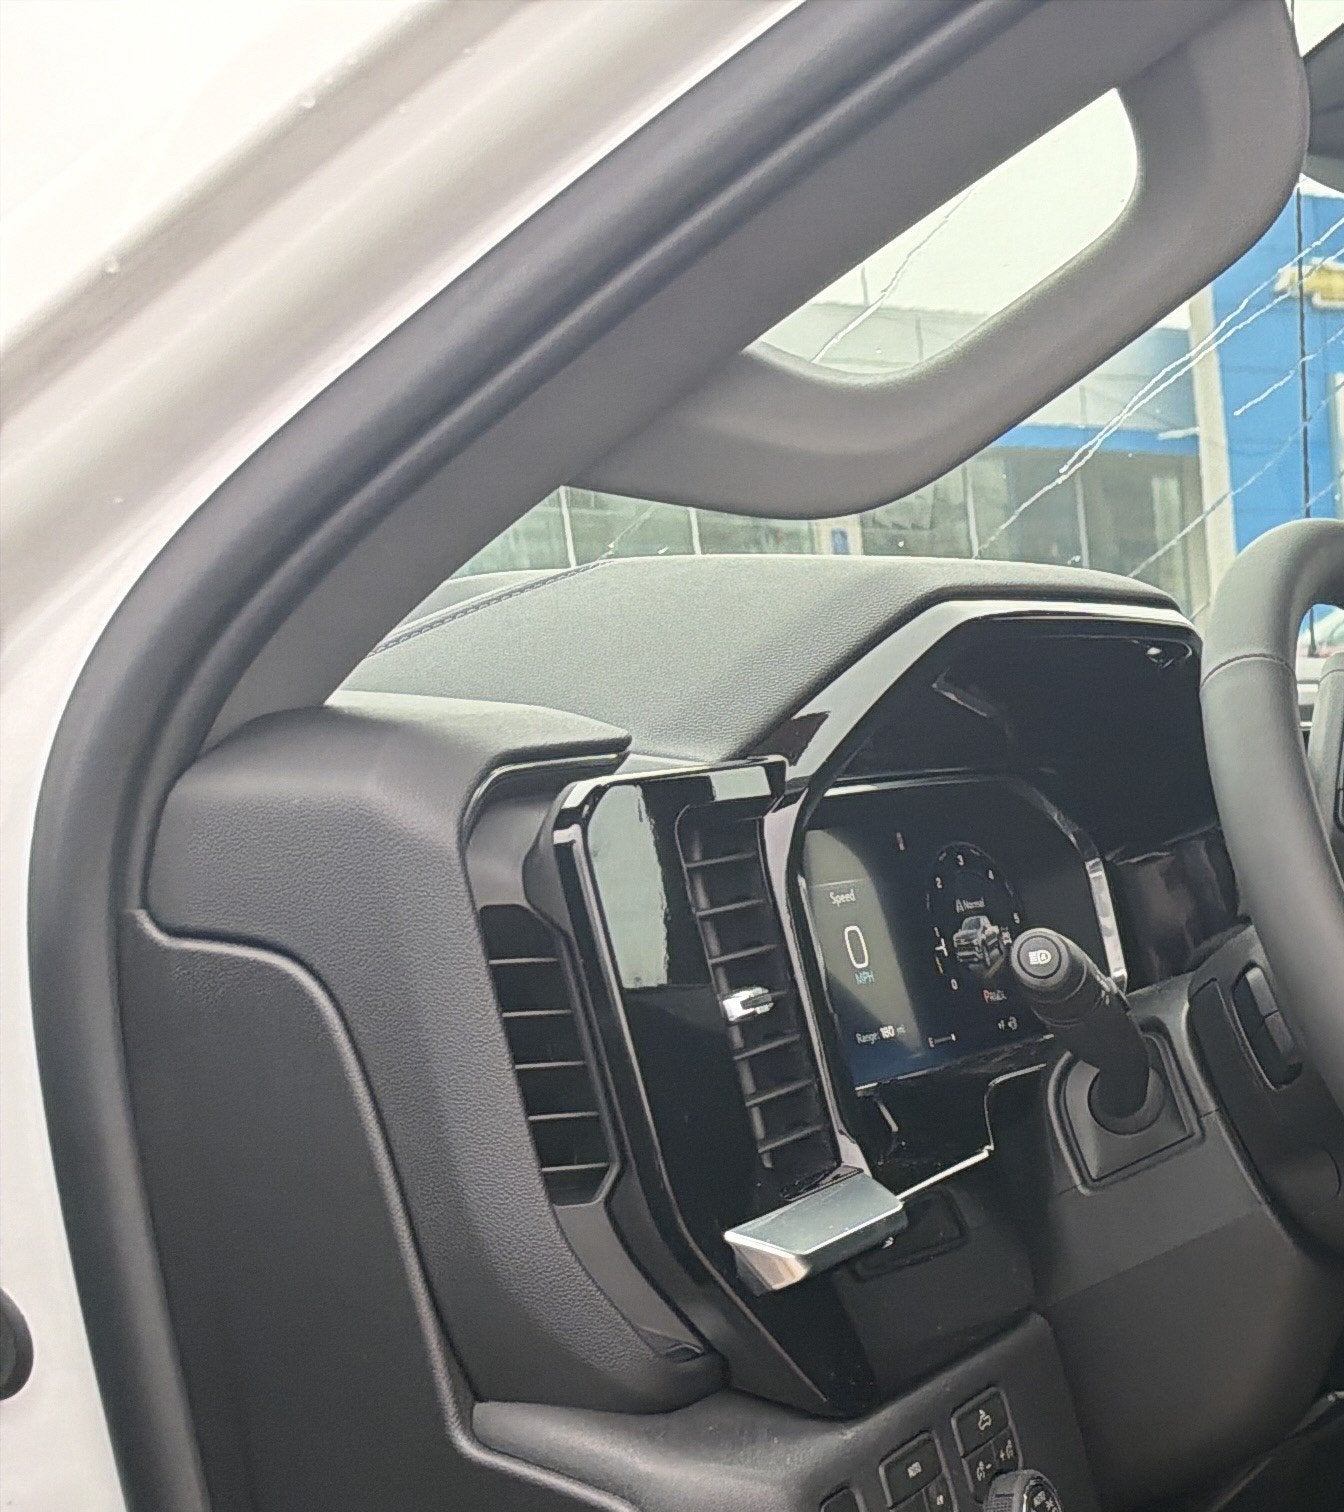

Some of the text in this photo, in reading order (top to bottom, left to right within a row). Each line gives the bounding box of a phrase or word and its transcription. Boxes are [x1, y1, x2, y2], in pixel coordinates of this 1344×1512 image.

[830, 889, 855, 906] Speed
[844, 925, 868, 968] 0
[855, 970, 875, 986] MPH
